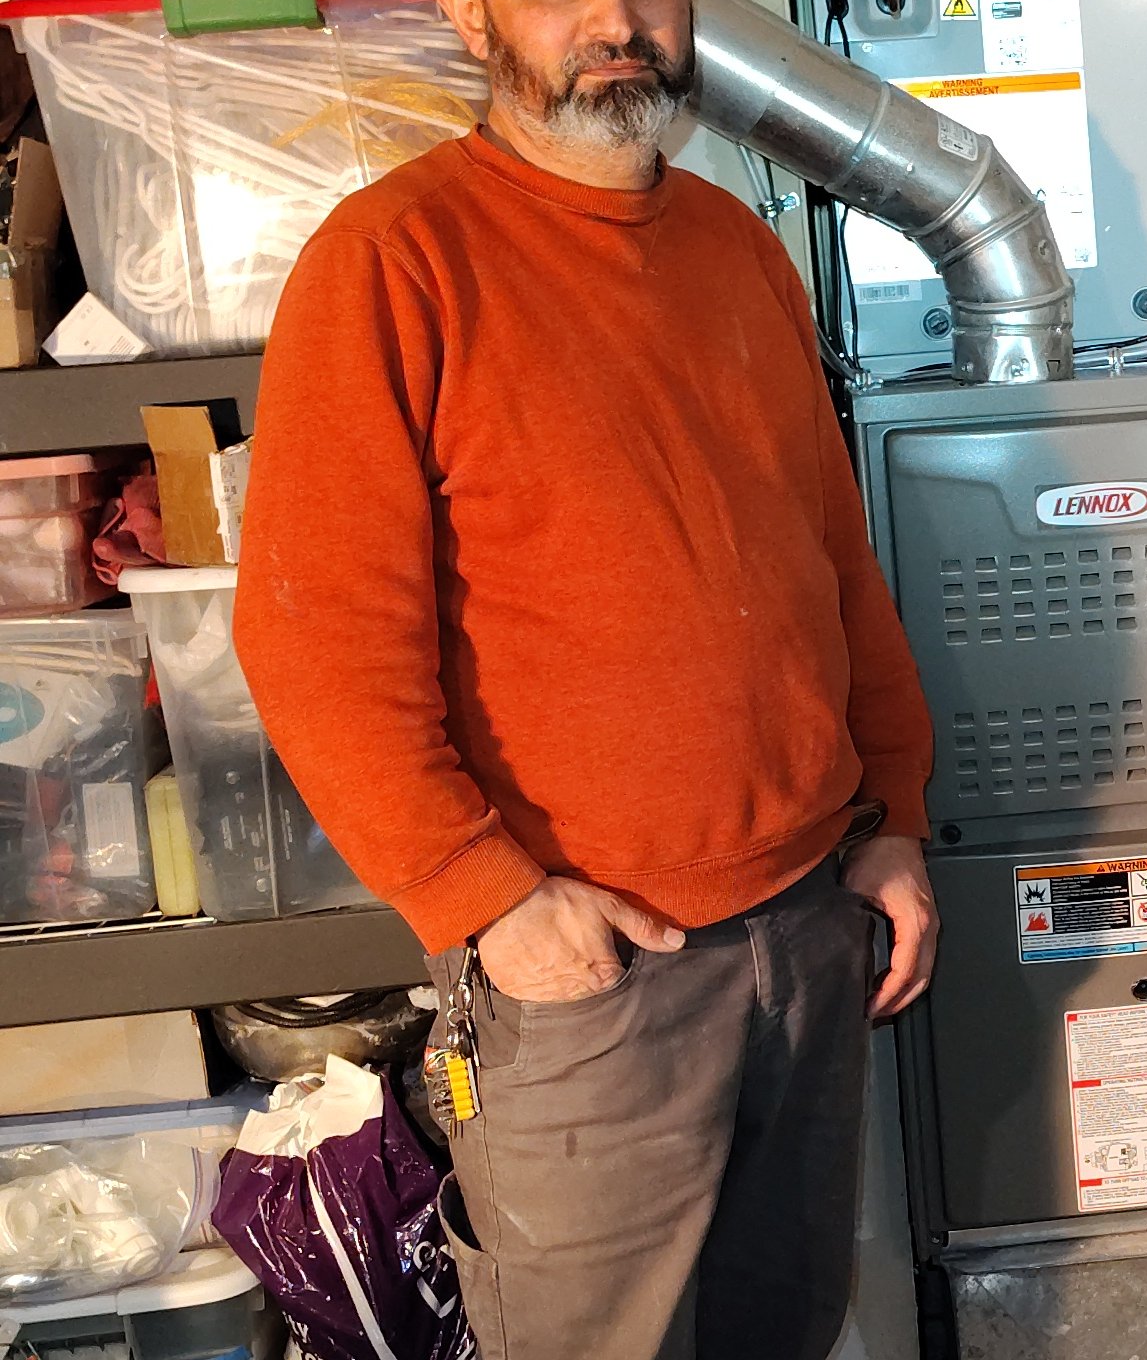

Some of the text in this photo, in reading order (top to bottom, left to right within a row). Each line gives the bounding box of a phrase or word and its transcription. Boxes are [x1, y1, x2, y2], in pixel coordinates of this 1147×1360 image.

[942, 78, 984, 88] WARNING
[929, 86, 1000, 99] AVERTISSEMENT
[1053, 493, 1135, 517] LENNOX
